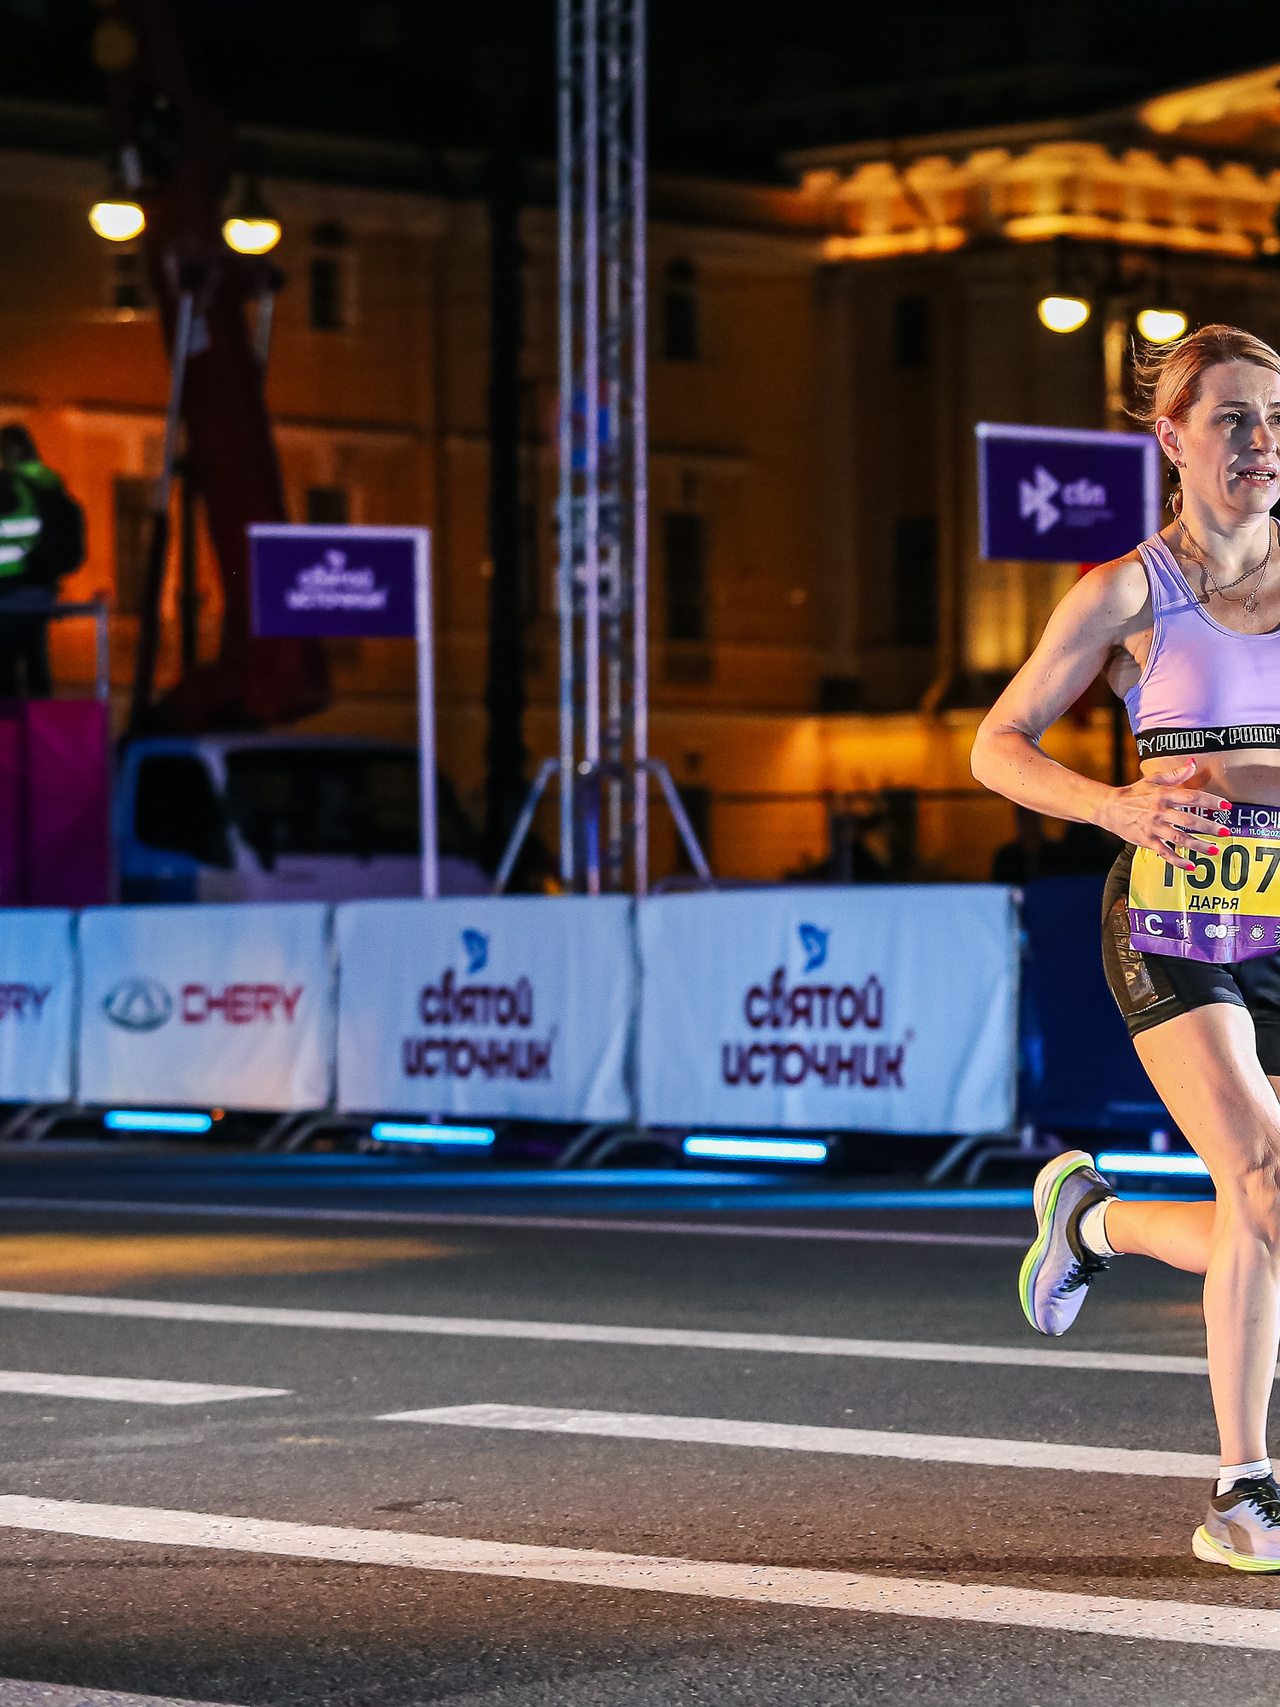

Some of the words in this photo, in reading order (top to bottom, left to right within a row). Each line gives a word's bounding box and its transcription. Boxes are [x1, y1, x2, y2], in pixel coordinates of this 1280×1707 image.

[1156, 731, 1205, 751] PUMA
[1228, 726, 1277, 744] PUMA
[1188, 895, 1240, 911] ДАРЬЯ
[0, 983, 50, 1023] RY
[182, 983, 304, 1024] CHERY
